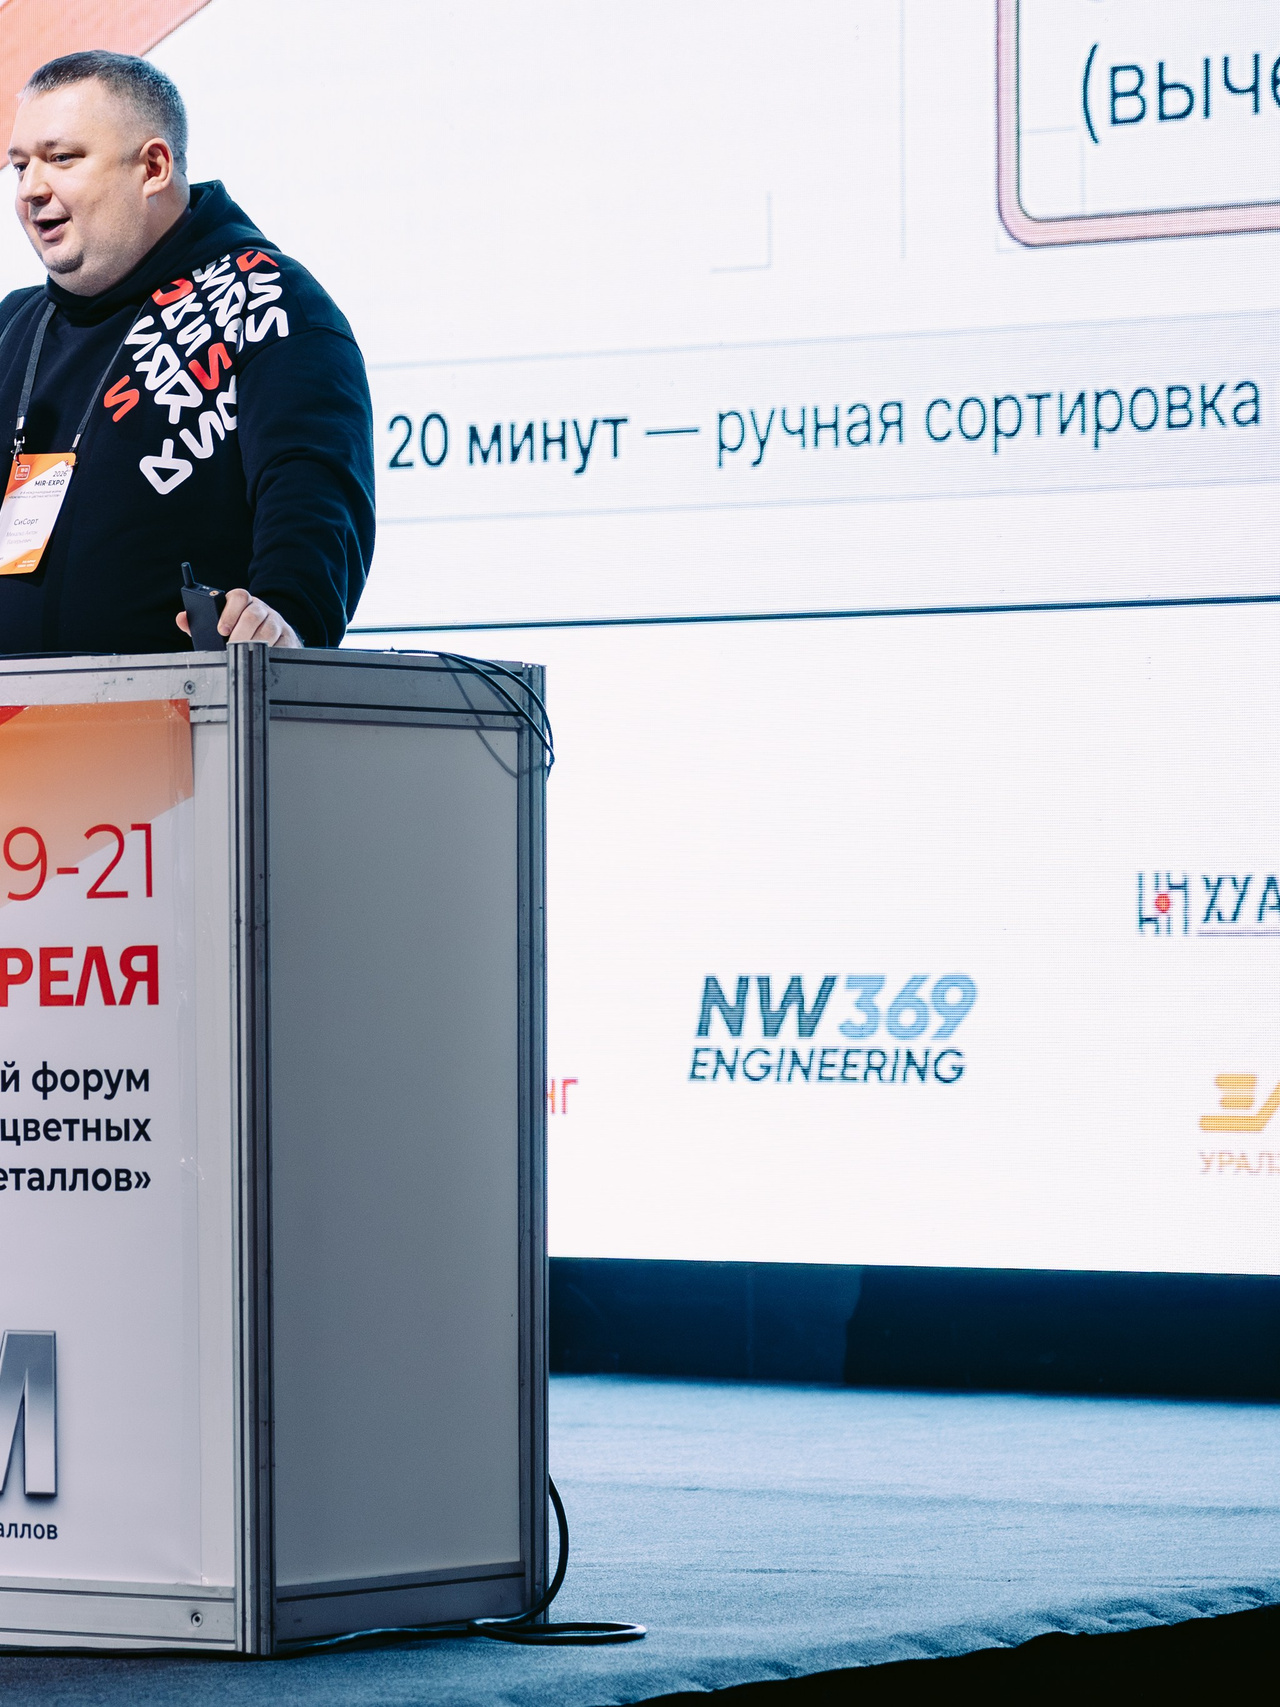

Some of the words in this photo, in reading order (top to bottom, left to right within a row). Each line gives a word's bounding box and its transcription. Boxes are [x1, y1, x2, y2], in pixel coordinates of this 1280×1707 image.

[1082, 42, 1280, 145] (выч
[387, 411, 450, 470] 20
[467, 414, 630, 477] минут
[716, 397, 905, 469] ручная
[924, 380, 1263, 456] сортировка
[31, 1061, 151, 1101] форум
[688, 1047, 966, 1084] ENGINEERING
[0, 1117, 152, 1147] цветных
